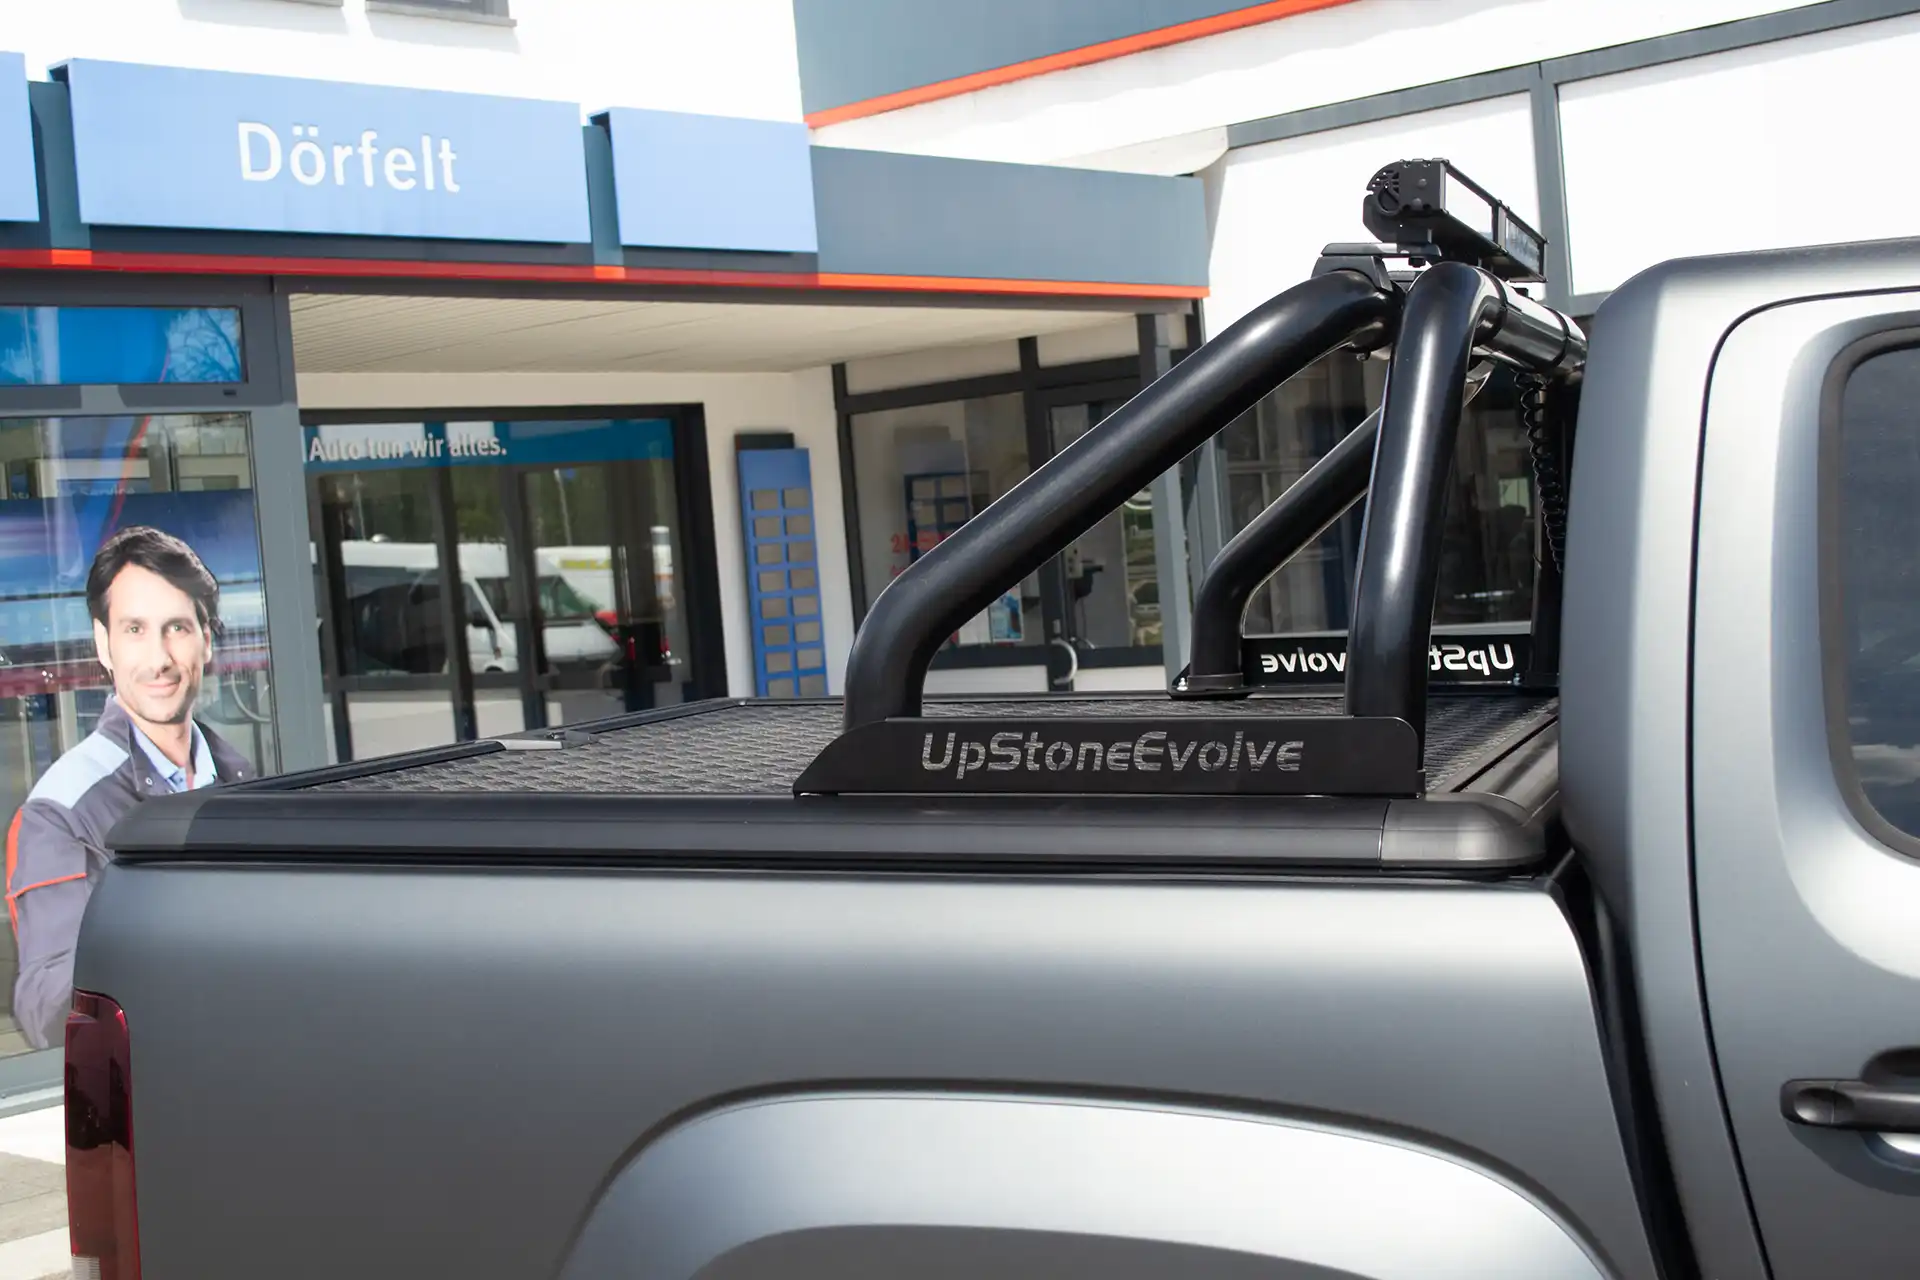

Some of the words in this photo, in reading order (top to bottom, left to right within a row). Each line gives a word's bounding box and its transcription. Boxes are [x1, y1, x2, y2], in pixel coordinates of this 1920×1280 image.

[237, 121, 461, 193] Dörfelt
[309, 436, 361, 462] Auto
[367, 437, 403, 459] tun
[410, 432, 444, 458] wir
[449, 433, 507, 456] alles.
[921, 730, 1304, 780] UpStoneEvolve
